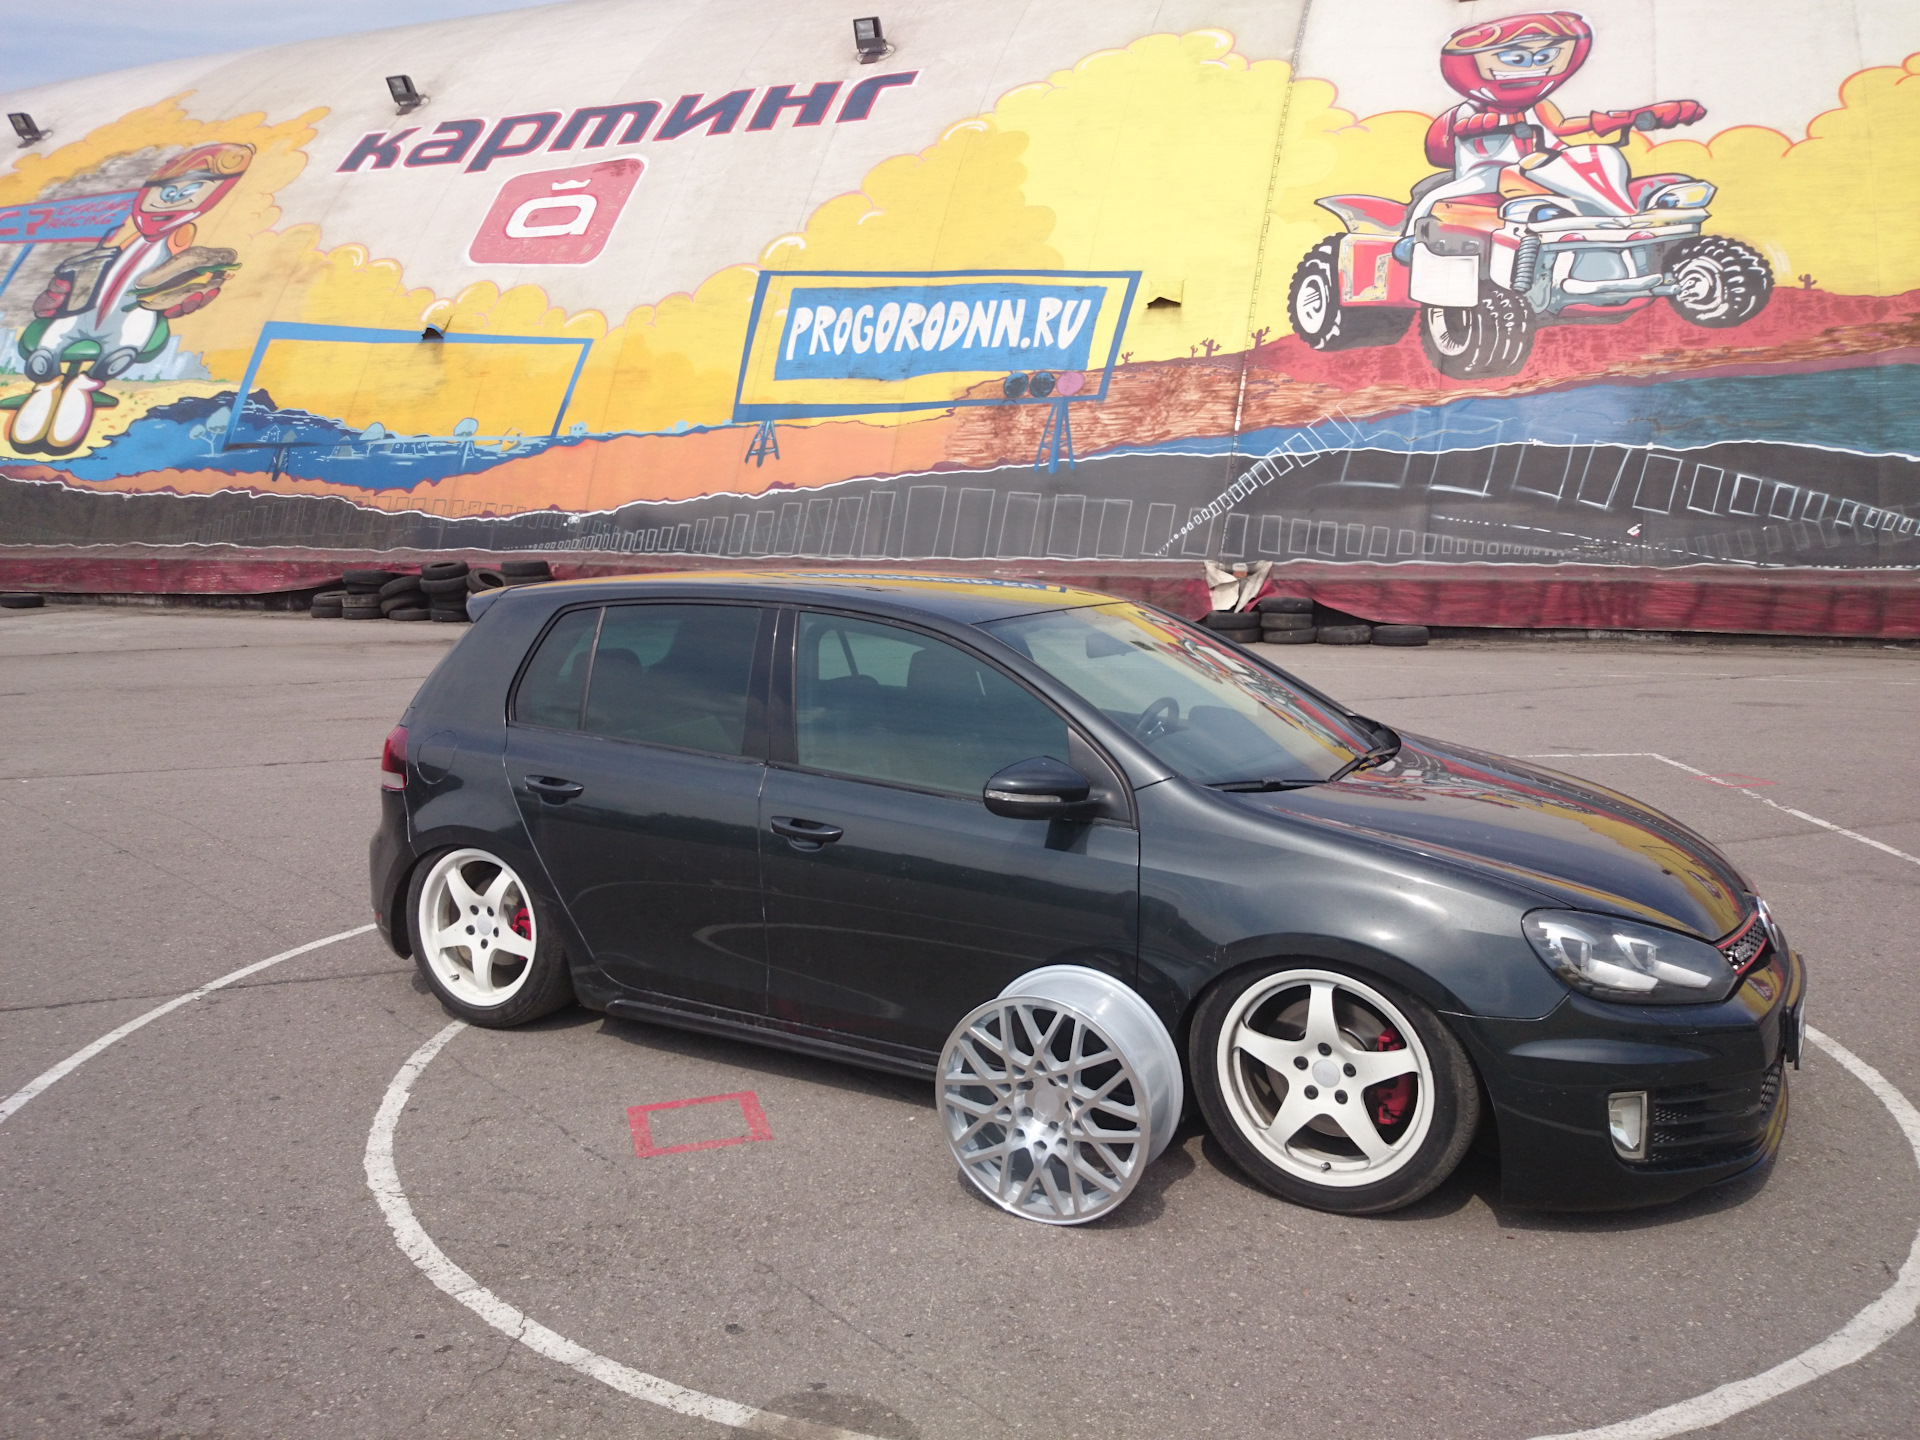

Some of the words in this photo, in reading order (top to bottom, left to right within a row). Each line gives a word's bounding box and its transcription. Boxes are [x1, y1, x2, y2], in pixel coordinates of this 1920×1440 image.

[57, 199, 132, 216] CHROME
[45, 213, 116, 230] RACING
[786, 297, 1091, 360] PROGORODNN.RU
